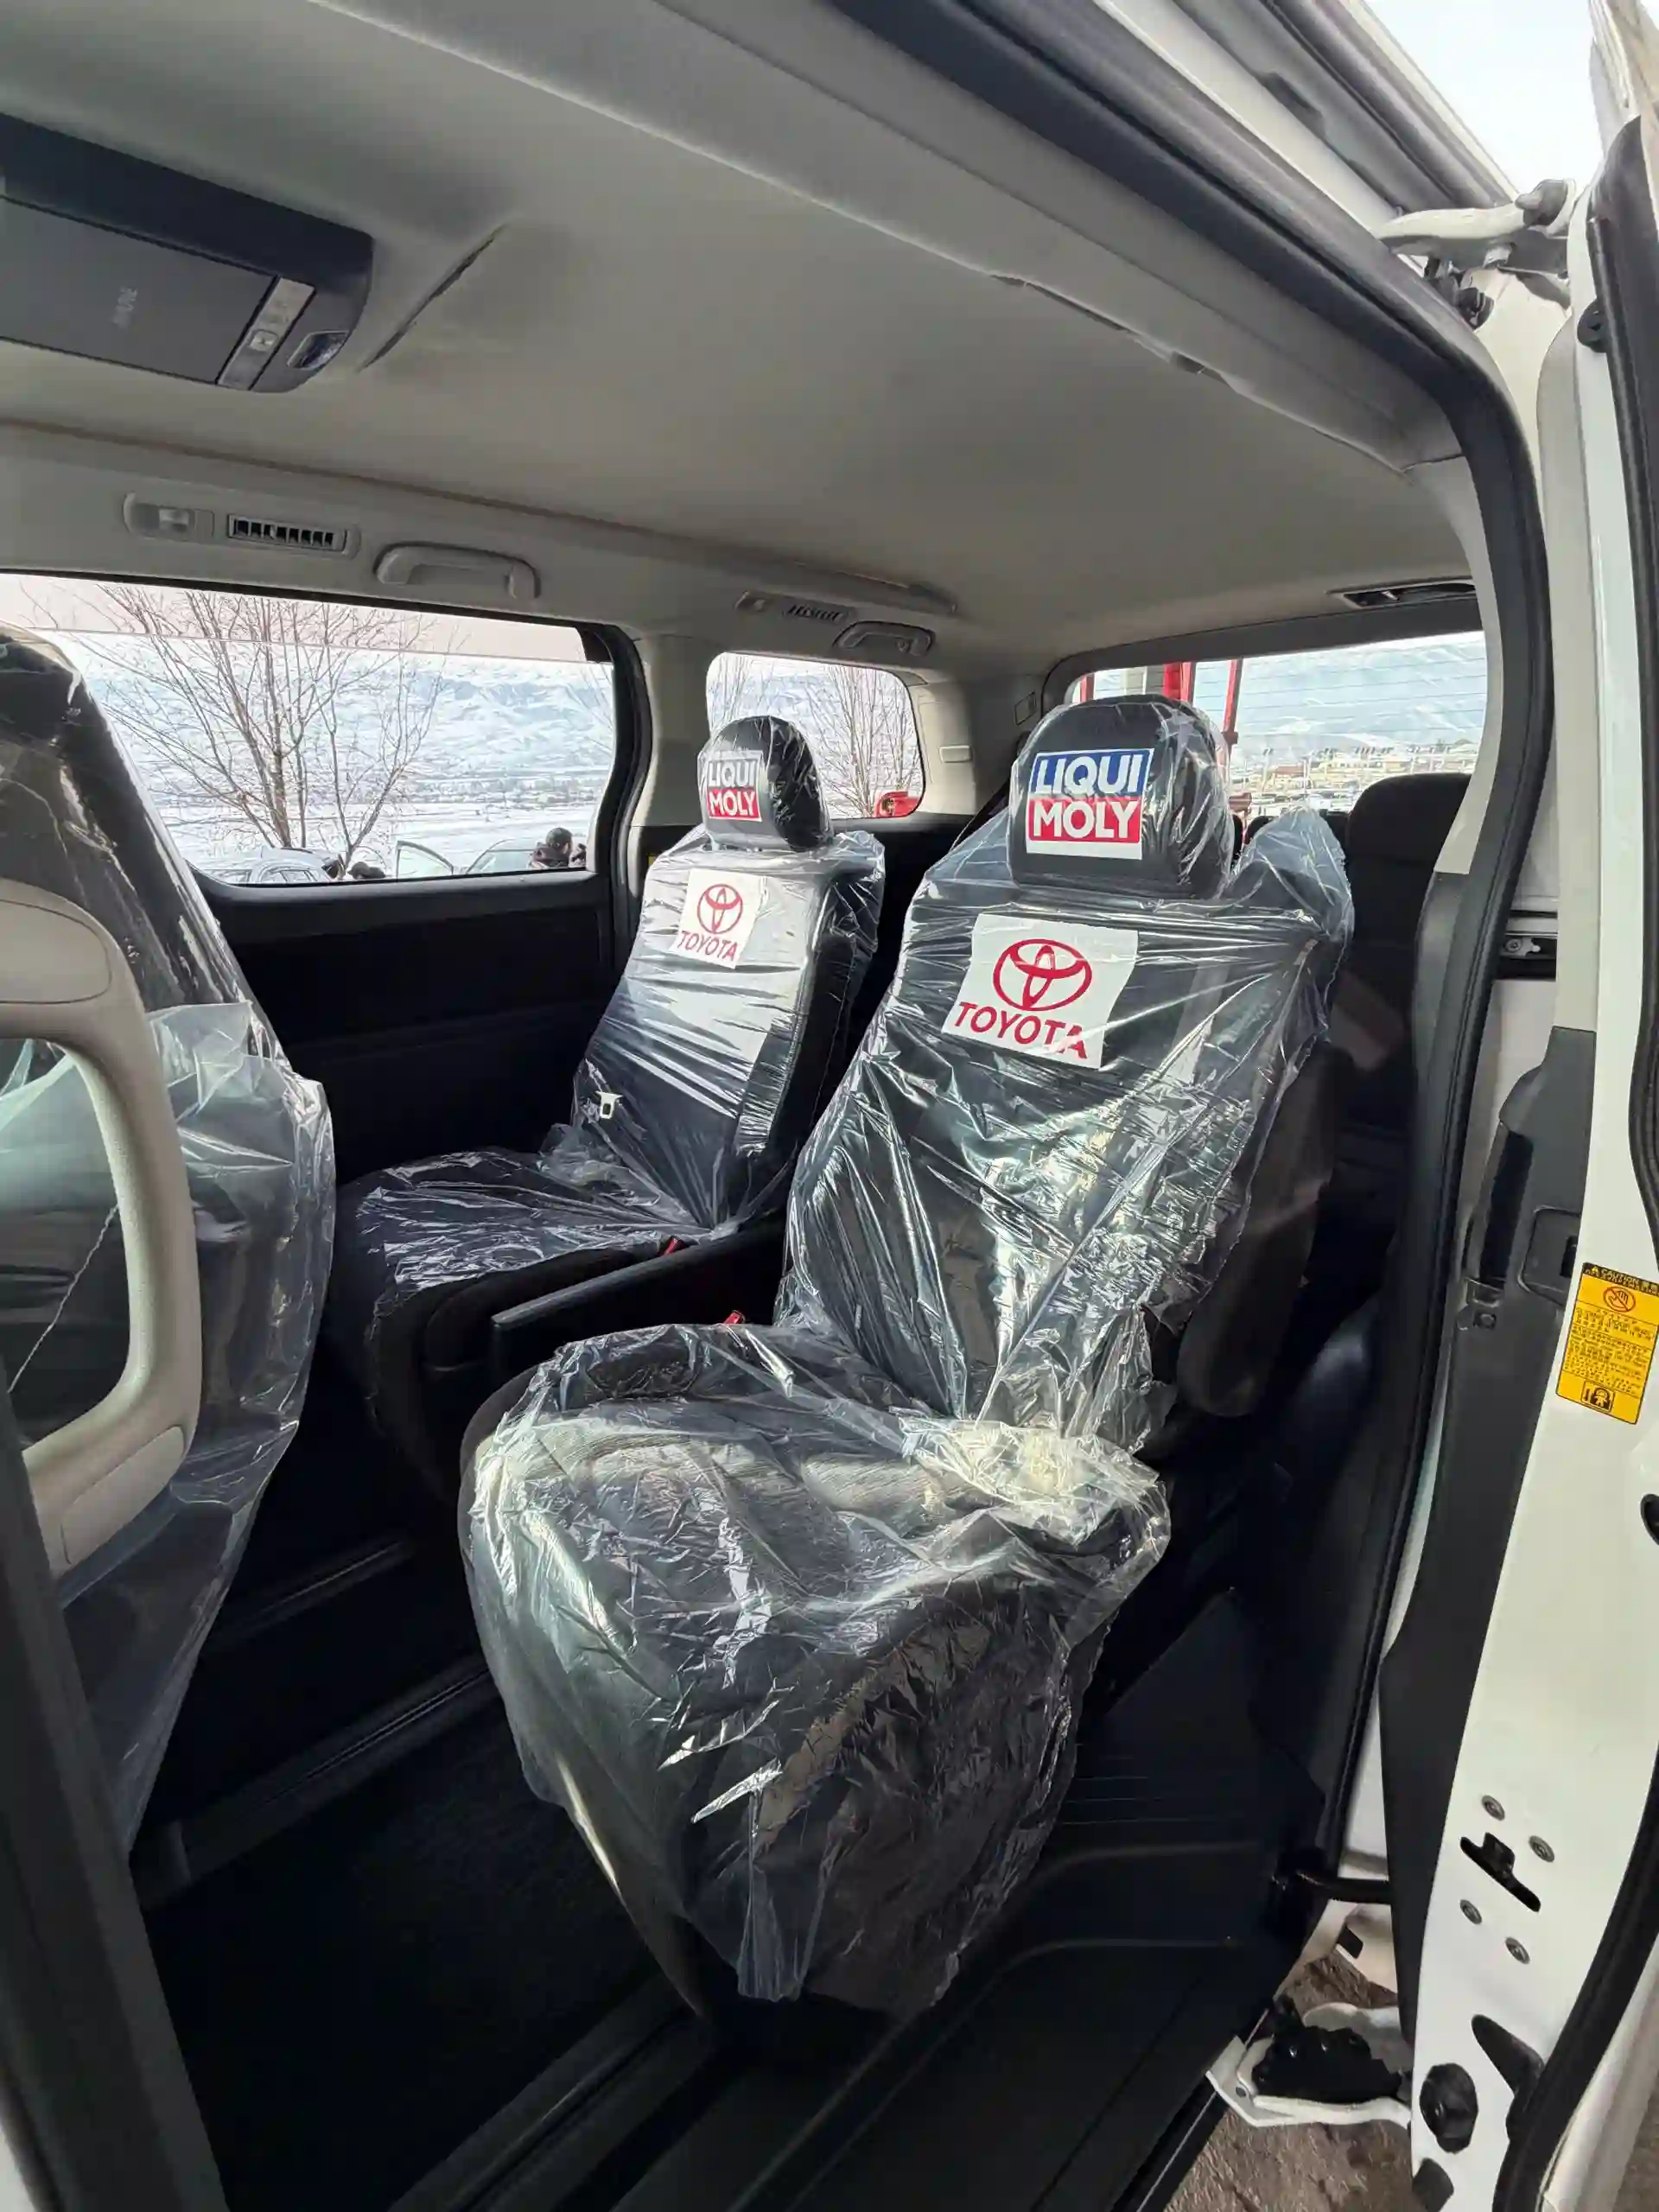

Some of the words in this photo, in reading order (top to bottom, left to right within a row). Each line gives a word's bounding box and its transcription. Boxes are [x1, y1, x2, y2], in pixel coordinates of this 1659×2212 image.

[709, 760, 755, 787] LIQUI
[1035, 754, 1142, 795] LIQUI
[709, 791, 755, 817] MOLY
[1033, 801, 1137, 838] MOLY
[677, 931, 738, 961] TOYOTA
